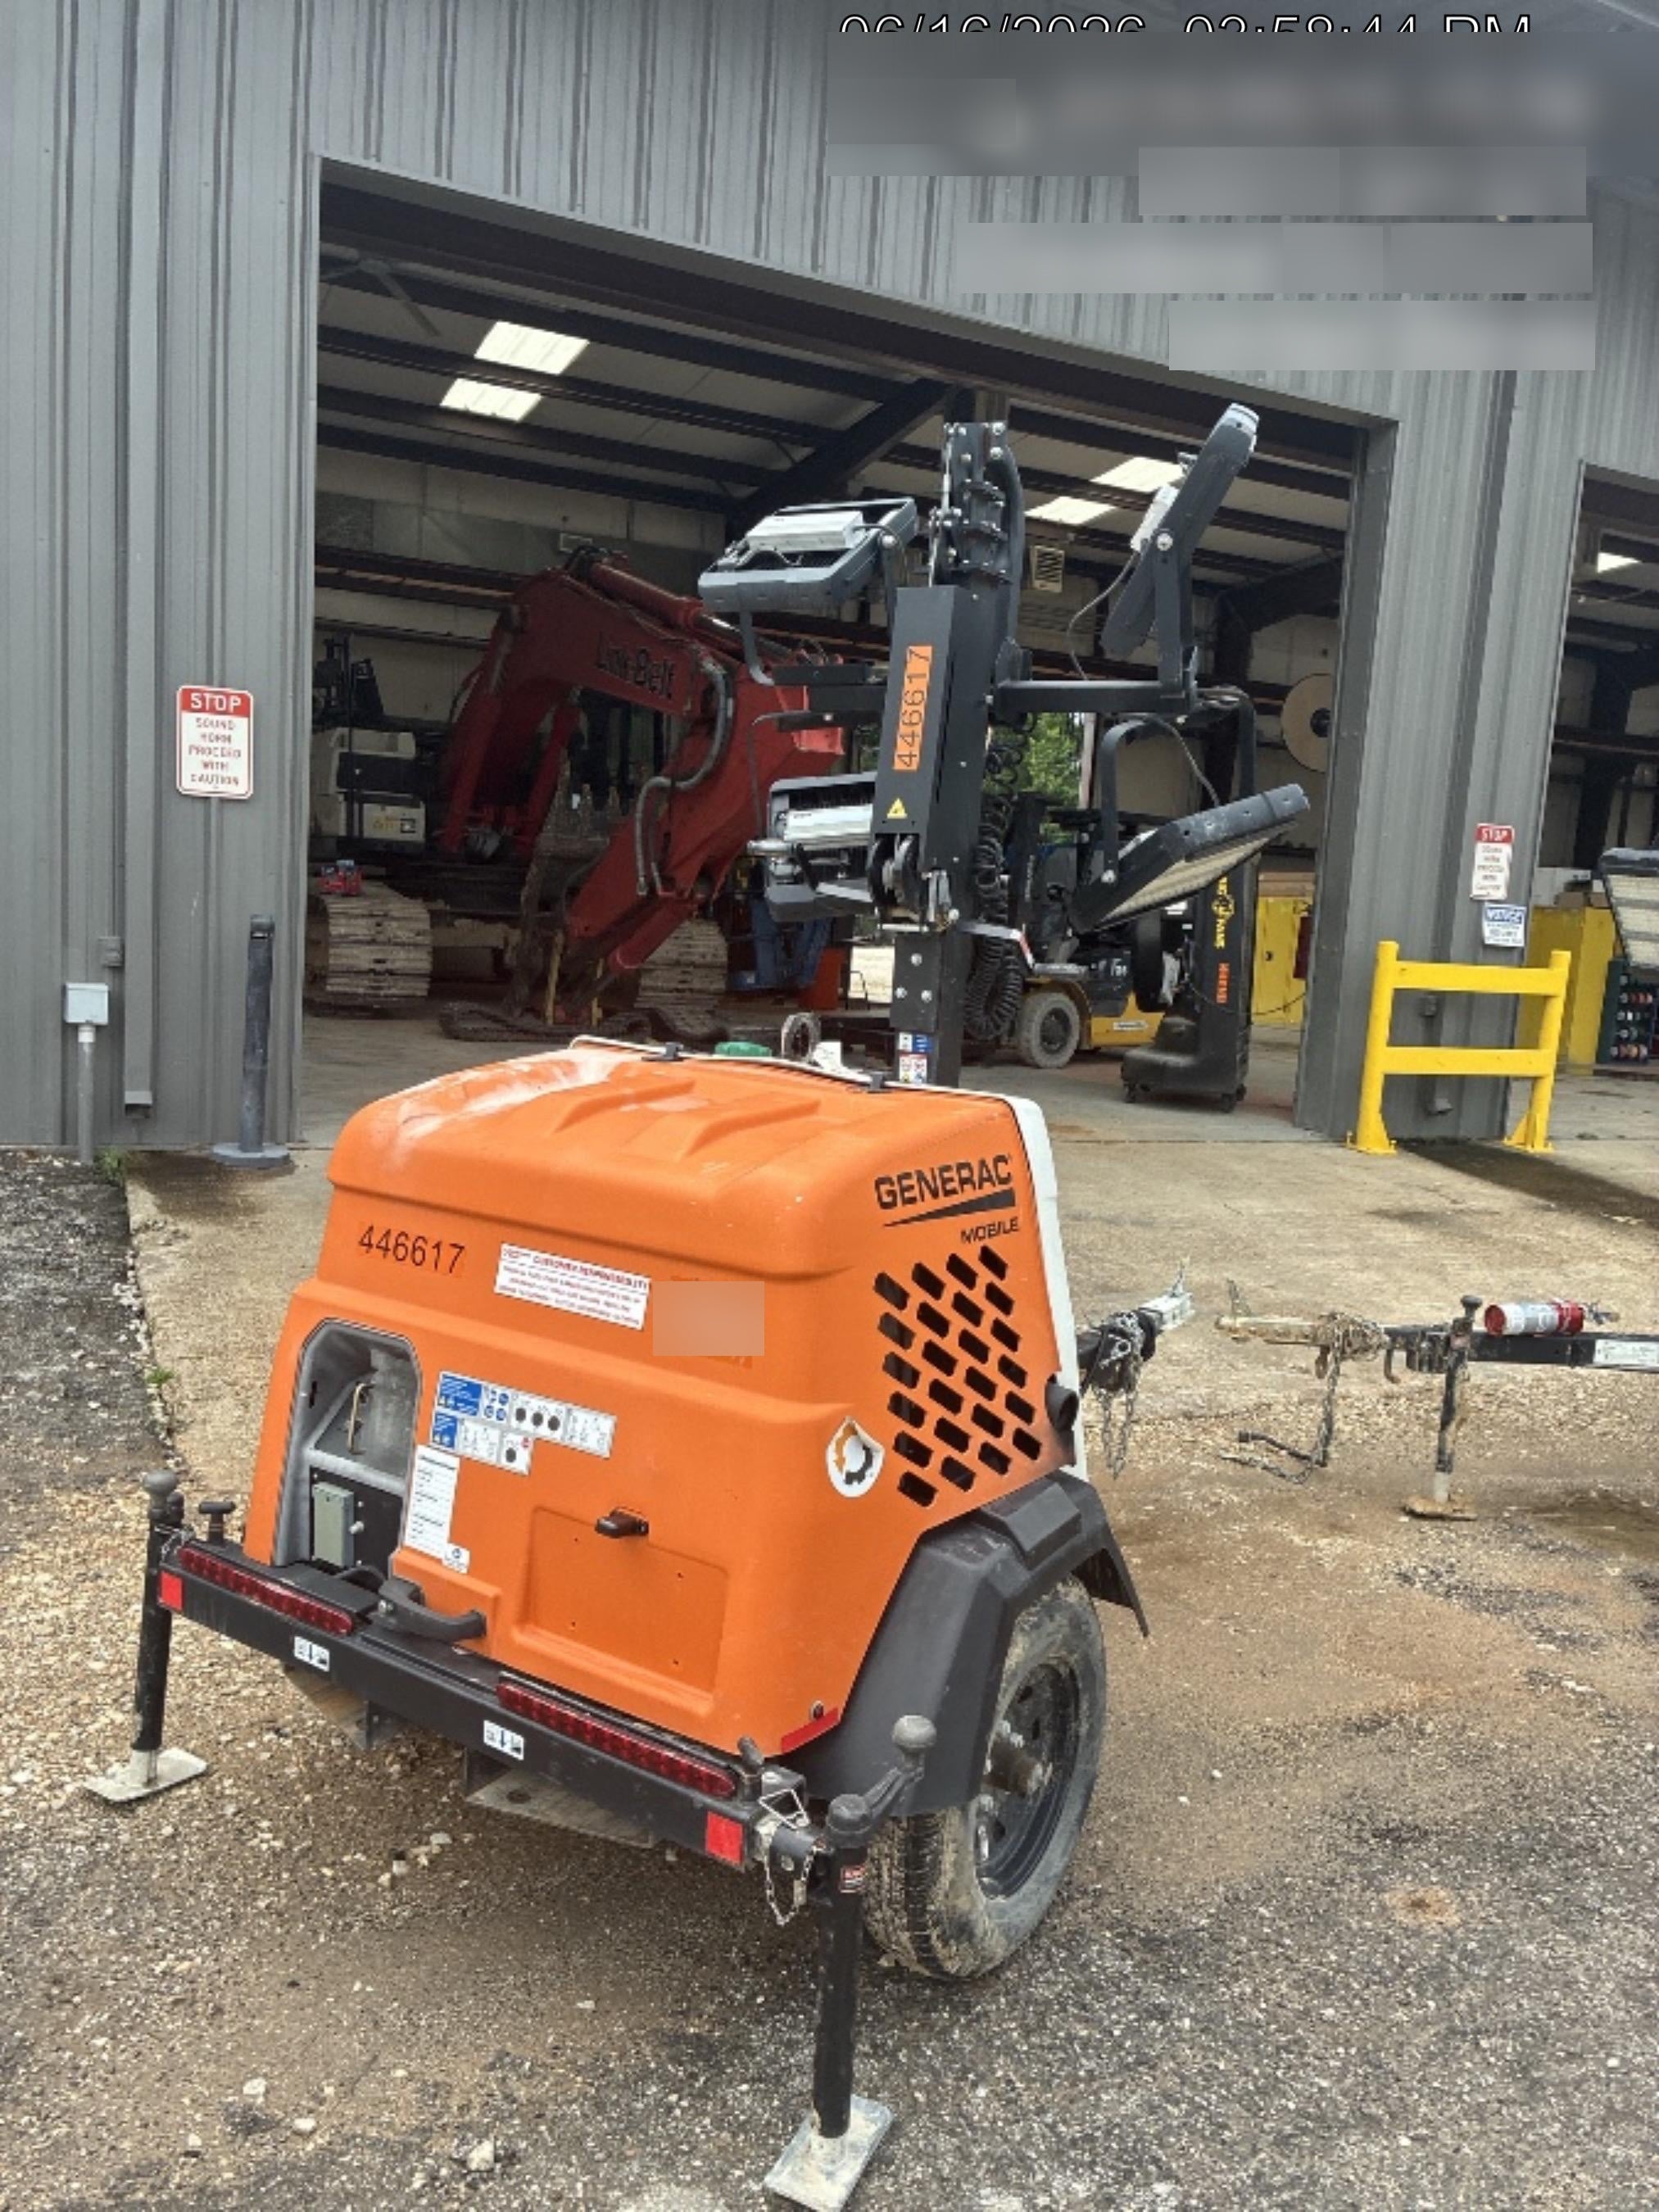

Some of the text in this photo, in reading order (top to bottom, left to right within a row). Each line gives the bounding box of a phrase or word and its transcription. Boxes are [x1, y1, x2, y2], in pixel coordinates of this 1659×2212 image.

[190, 691, 243, 714] STOP
[897, 648, 929, 768] 446617
[874, 1154, 1013, 1209] GENERAC
[358, 1224, 465, 1274] 446617
[960, 1216, 1019, 1244] MOBILE
